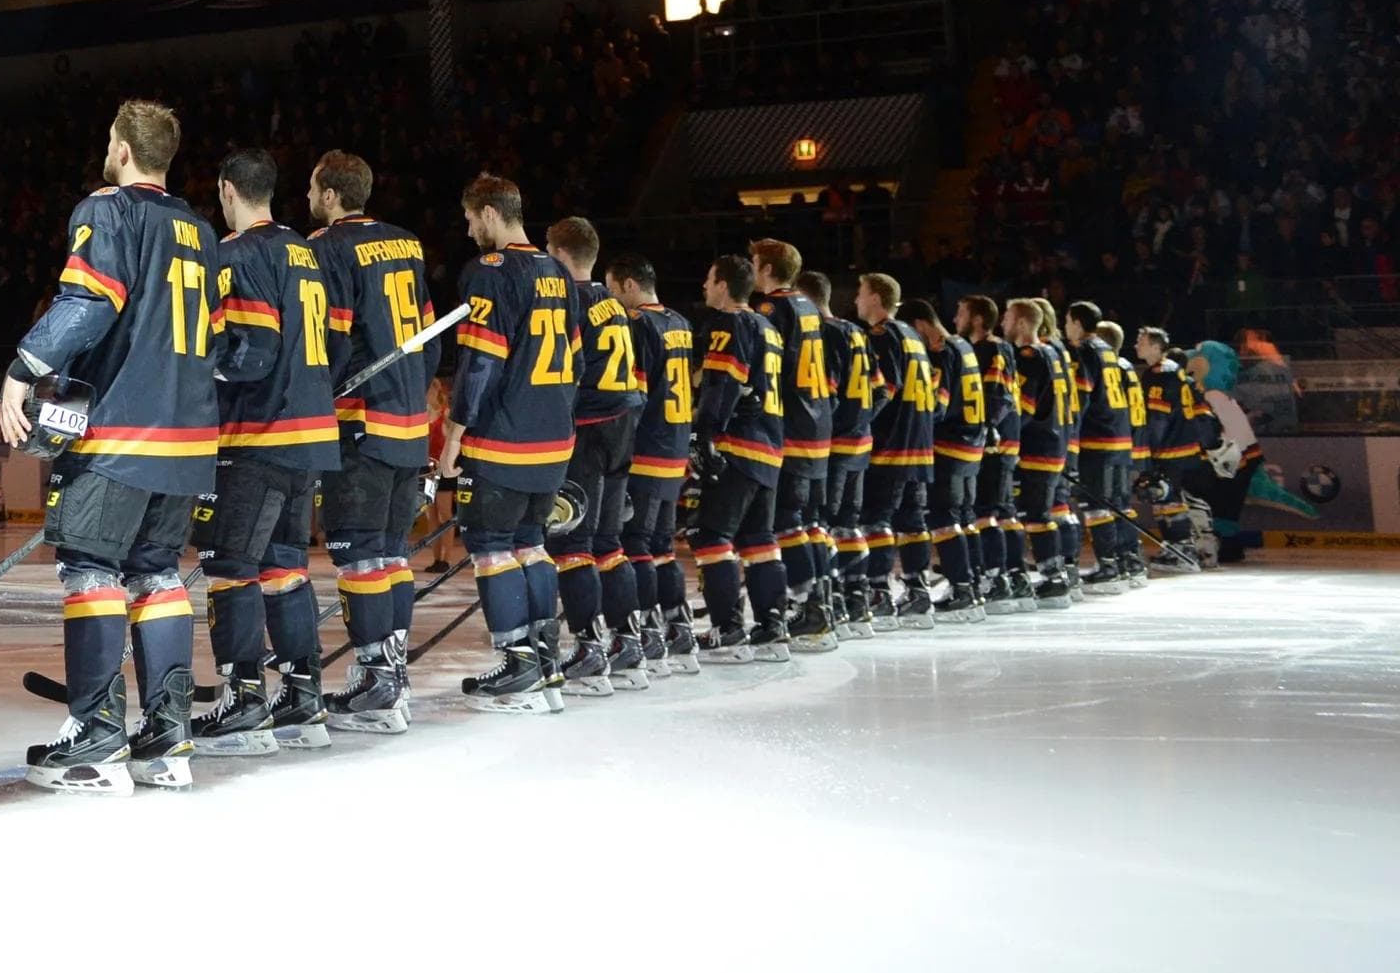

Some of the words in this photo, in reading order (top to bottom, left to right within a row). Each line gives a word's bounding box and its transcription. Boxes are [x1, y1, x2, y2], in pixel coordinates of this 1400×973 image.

[172, 219, 201, 251] KINK
[167, 257, 211, 357] 17
[299, 278, 330, 366] 18
[383, 270, 425, 353] 19
[469, 296, 493, 325] 22
[46, 407, 87, 433] 2017
